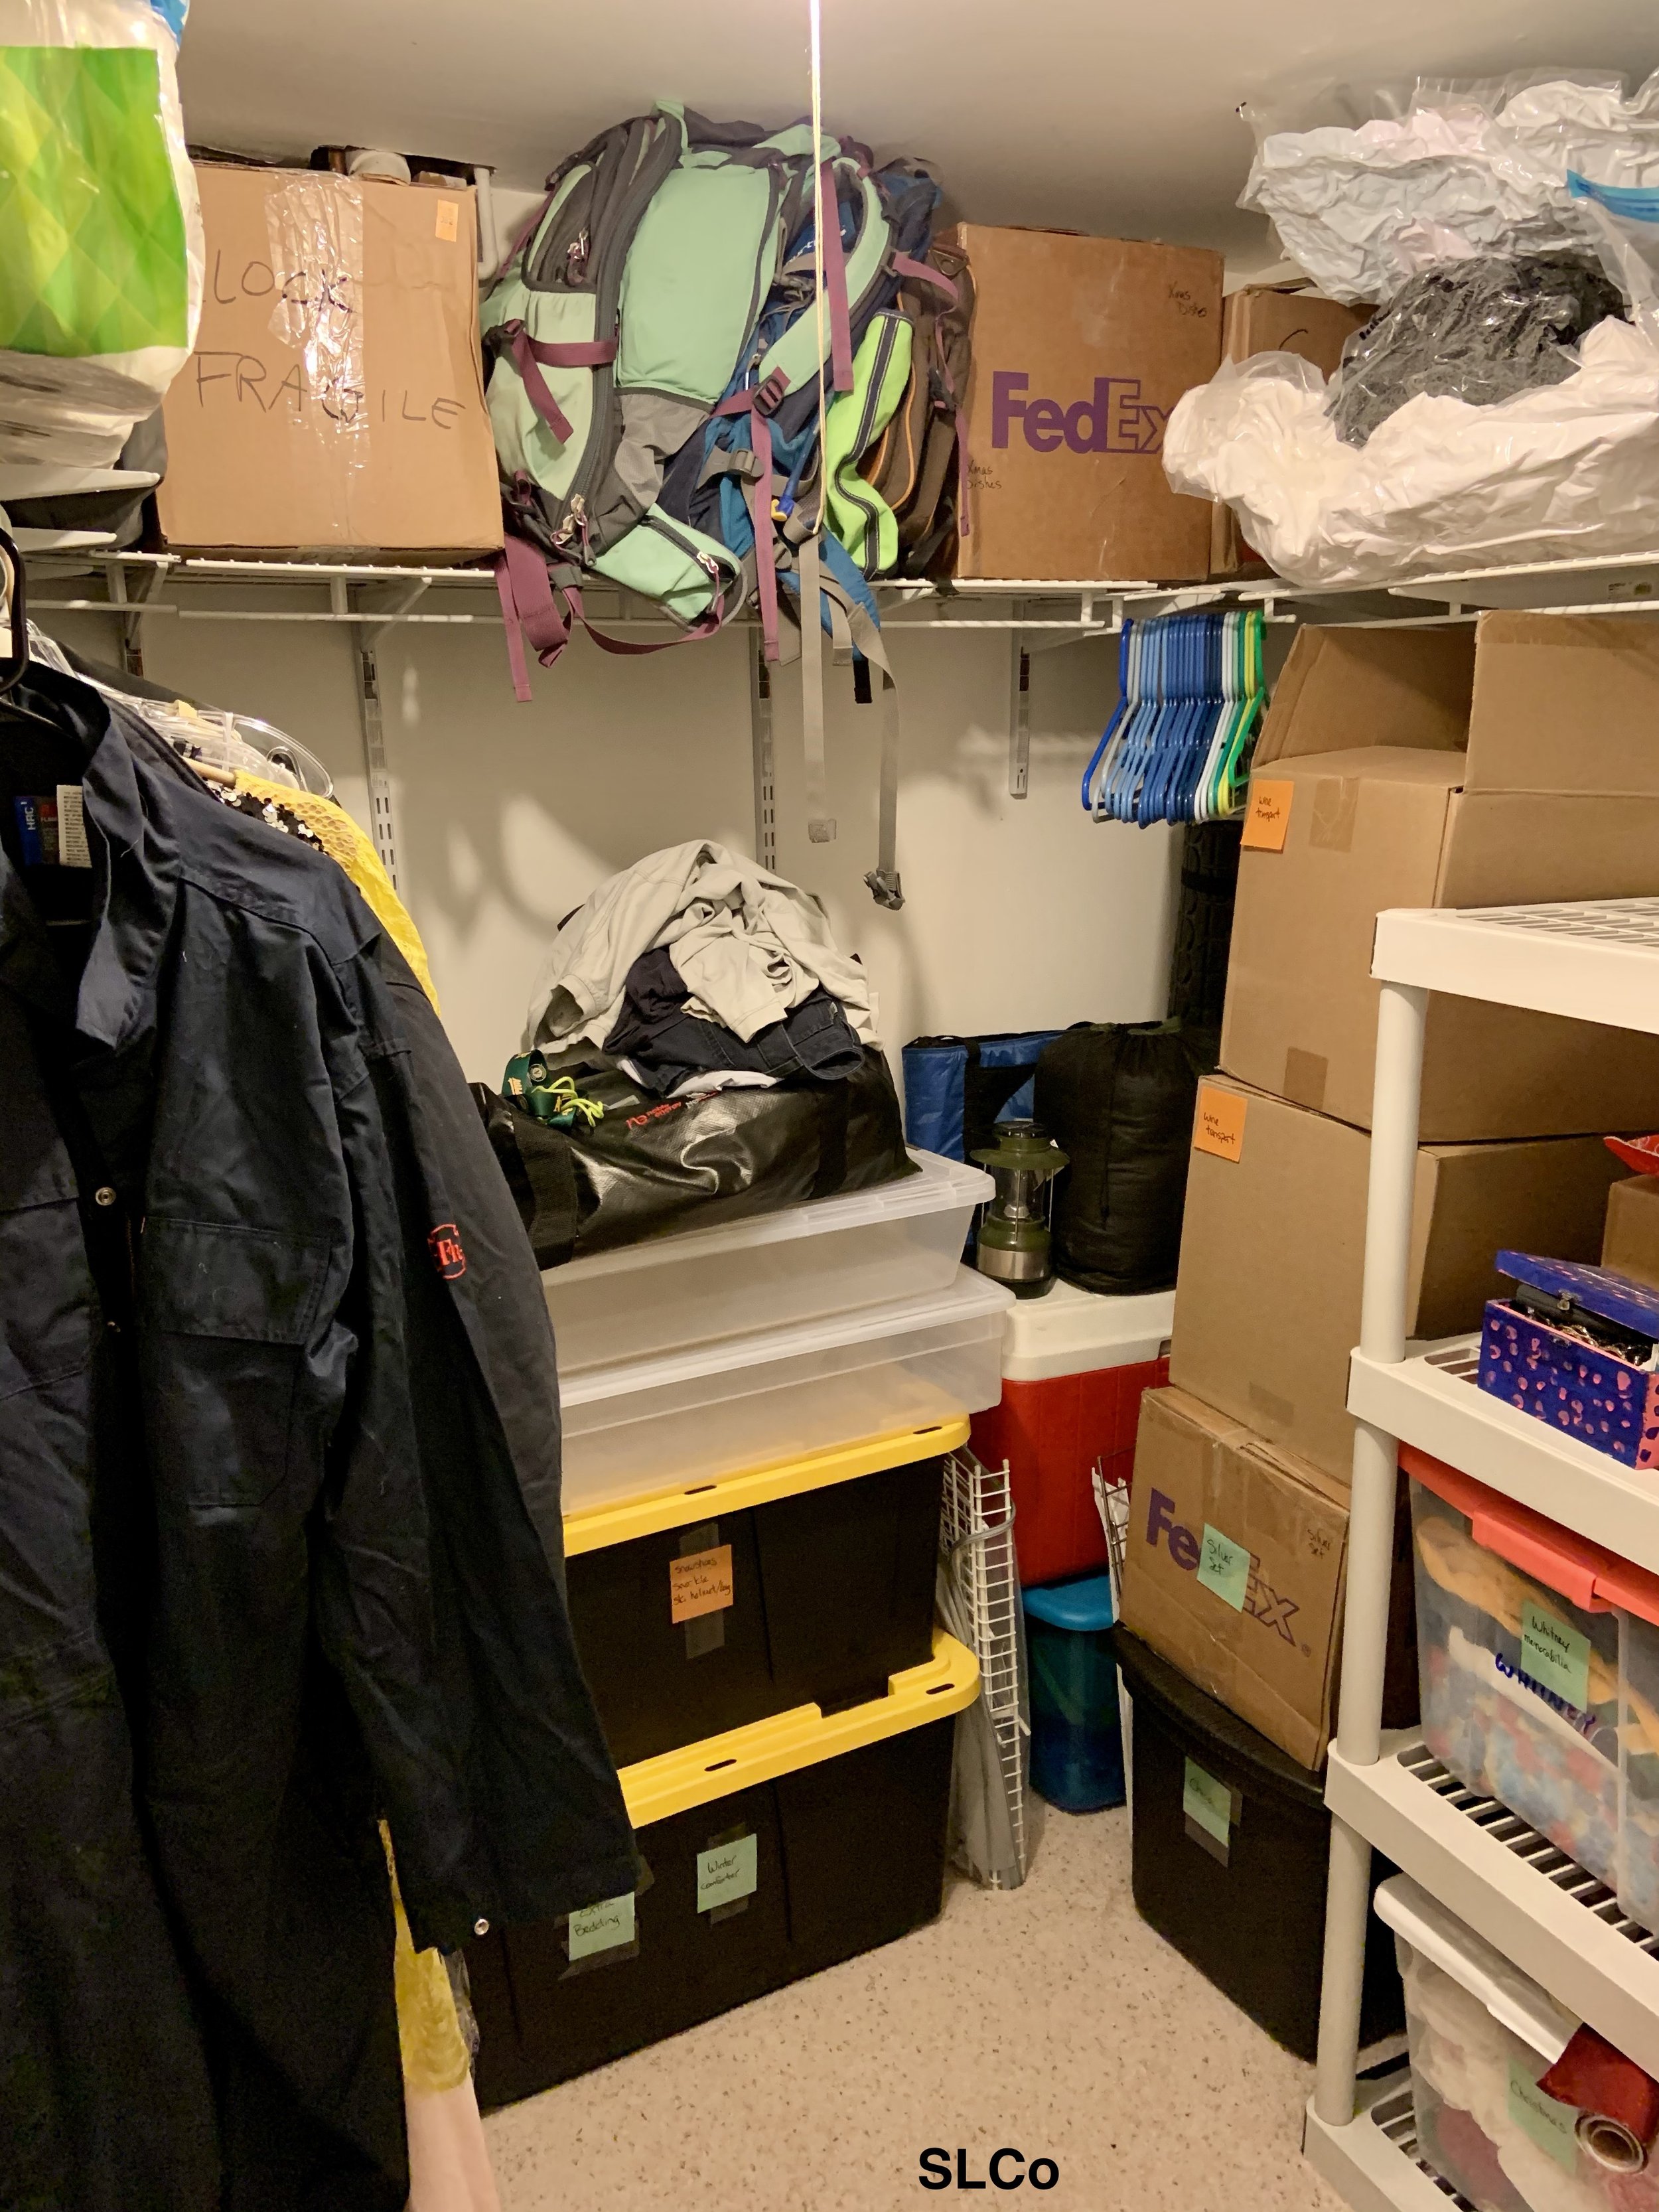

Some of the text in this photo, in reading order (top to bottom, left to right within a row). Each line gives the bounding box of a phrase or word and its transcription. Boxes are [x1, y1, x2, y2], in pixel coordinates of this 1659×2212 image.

[194, 350, 467, 429] FRAGILE
[968, 459, 993, 475] Xmas
[1146, 1487, 1301, 1647] FeEx
[707, 1854, 737, 1874] Winter
